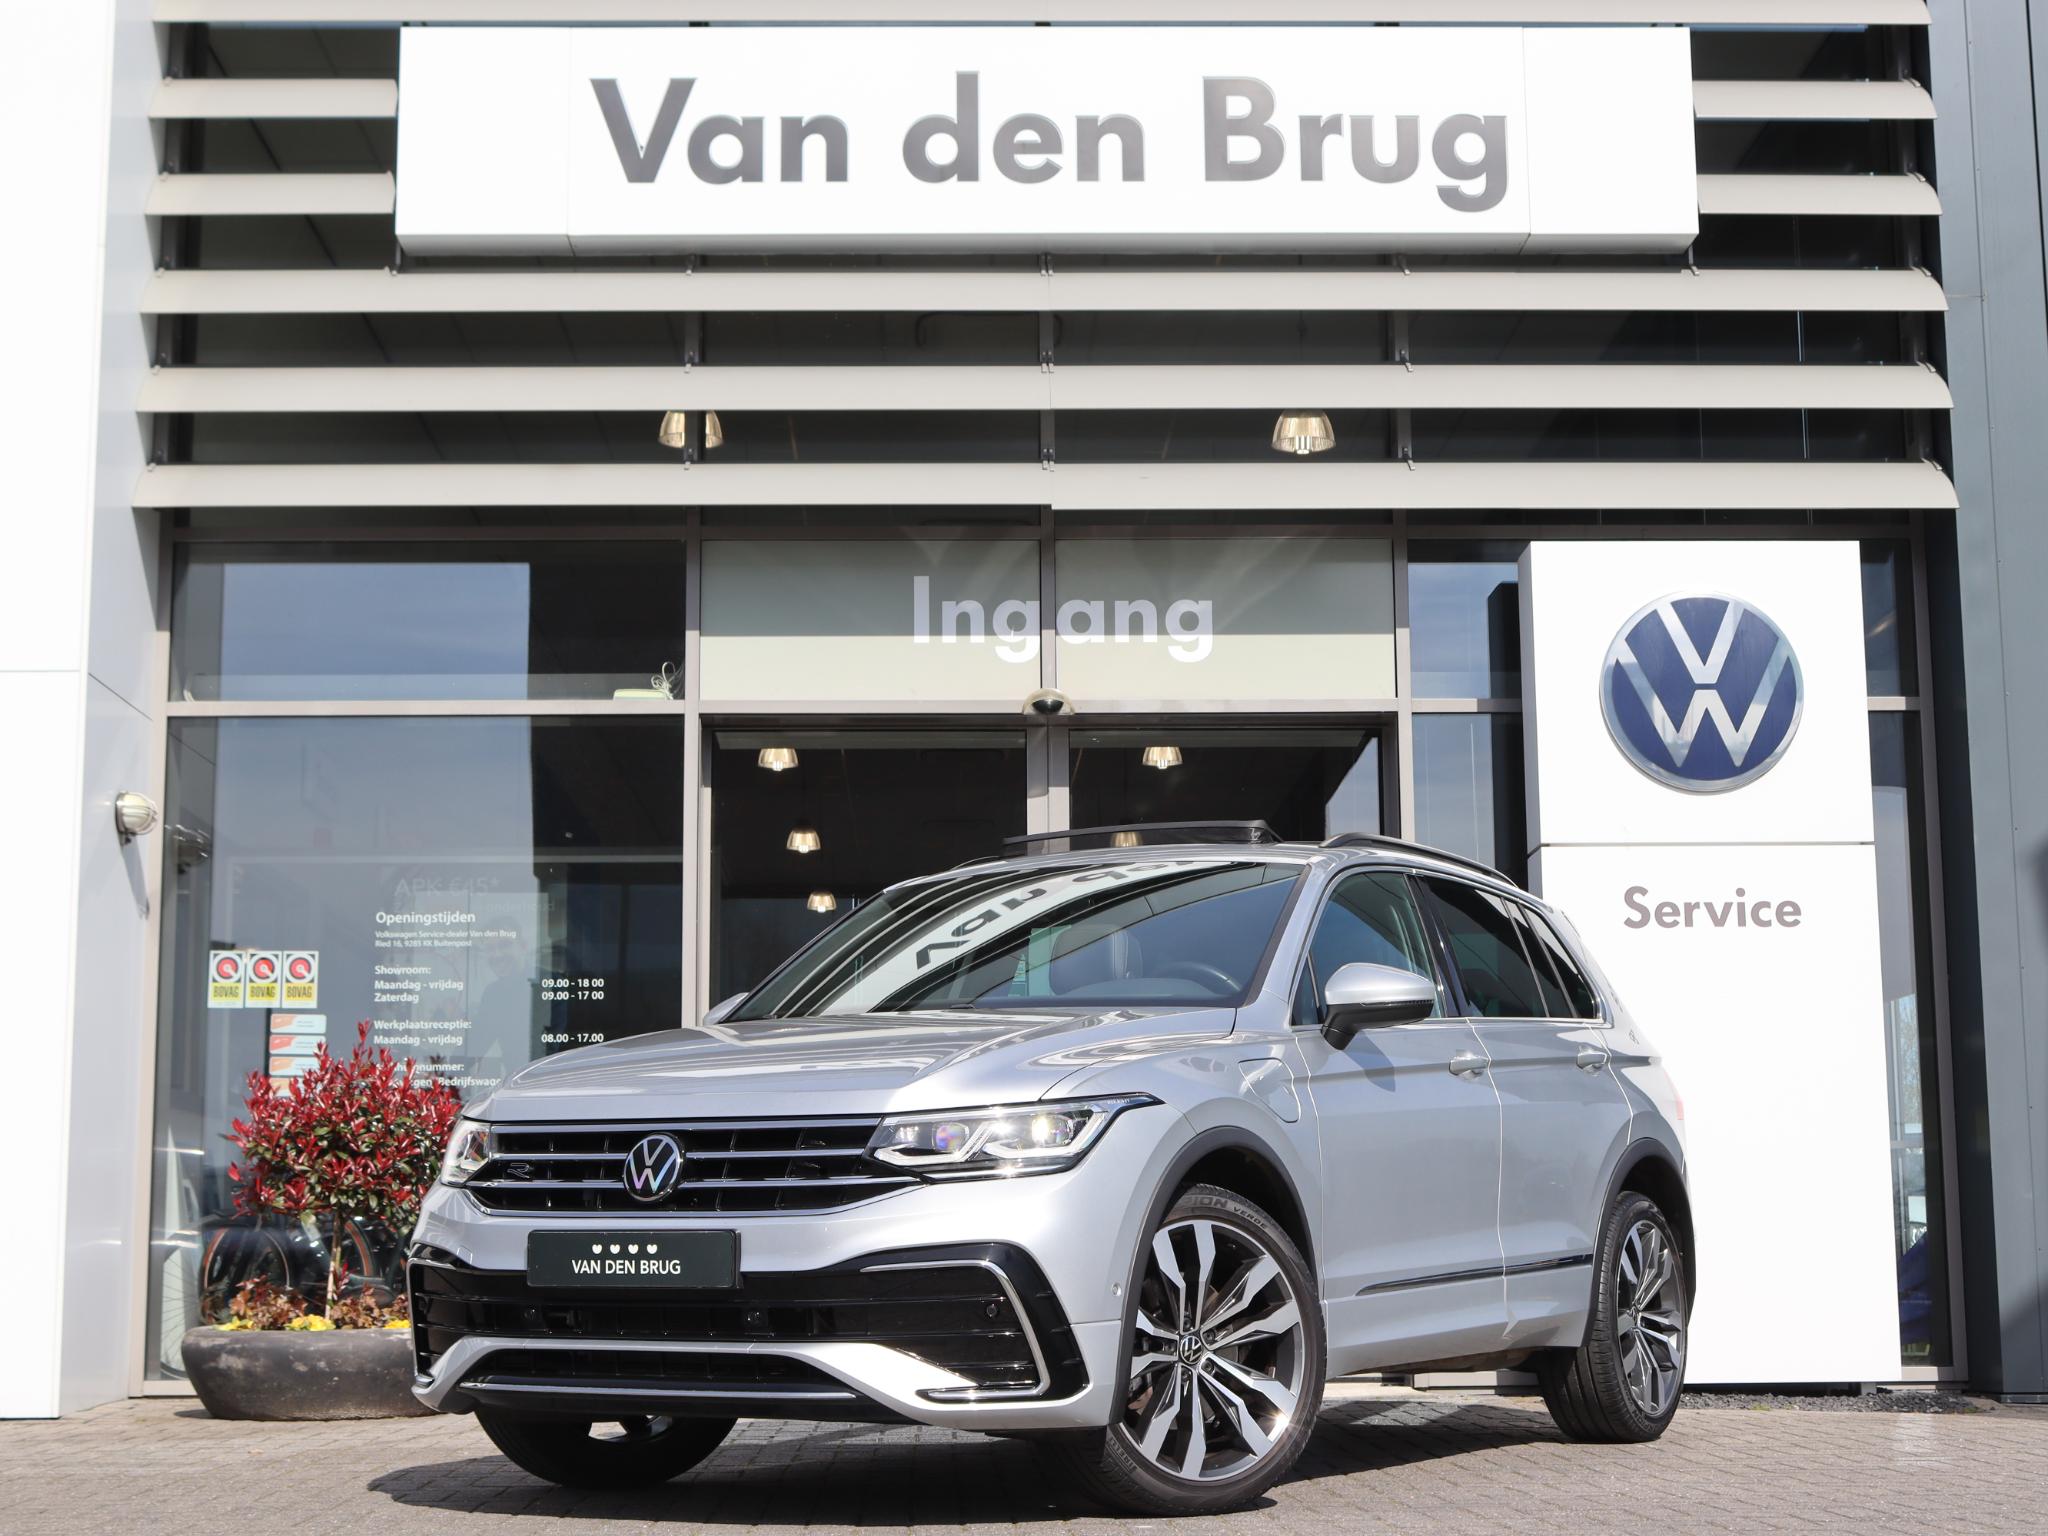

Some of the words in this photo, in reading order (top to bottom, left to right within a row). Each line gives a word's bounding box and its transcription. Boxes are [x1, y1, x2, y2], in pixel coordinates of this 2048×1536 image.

[589, 77, 848, 185] Van
[902, 70, 1145, 184] den
[1202, 76, 1508, 213] Brug
[913, 575, 1213, 663] Ingang
[1624, 885, 1802, 930] Service
[375, 911, 476, 927] Openingstijden
[470, 930, 483, 938] Van
[484, 929, 499, 938] den
[500, 929, 517, 939] Brug
[374, 965, 432, 976] Showroom:
[374, 980, 421, 991] Maandag
[428, 979, 464, 991] vrijdag
[541, 979, 569, 988] 09.00
[213, 986, 239, 998] BOVAG
[249, 986, 276, 998] BOVAG
[286, 986, 312, 998] BOVAG
[541, 991, 569, 1000] 09.00
[374, 993, 419, 1004] Zaterdag
[373, 1019, 473, 1030] Werkplaatsreceptie:
[373, 1035, 421, 1046] Maandag
[427, 1034, 463, 1046] vrijdag
[541, 1034, 569, 1043] 08.00
[577, 1033, 604, 1042] 17.00
[1232, 1206, 1268, 1229] VERDE
[571, 1259, 601, 1275] VAN
[605, 1259, 636, 1275] DEN
[640, 1259, 681, 1275] BRUG
